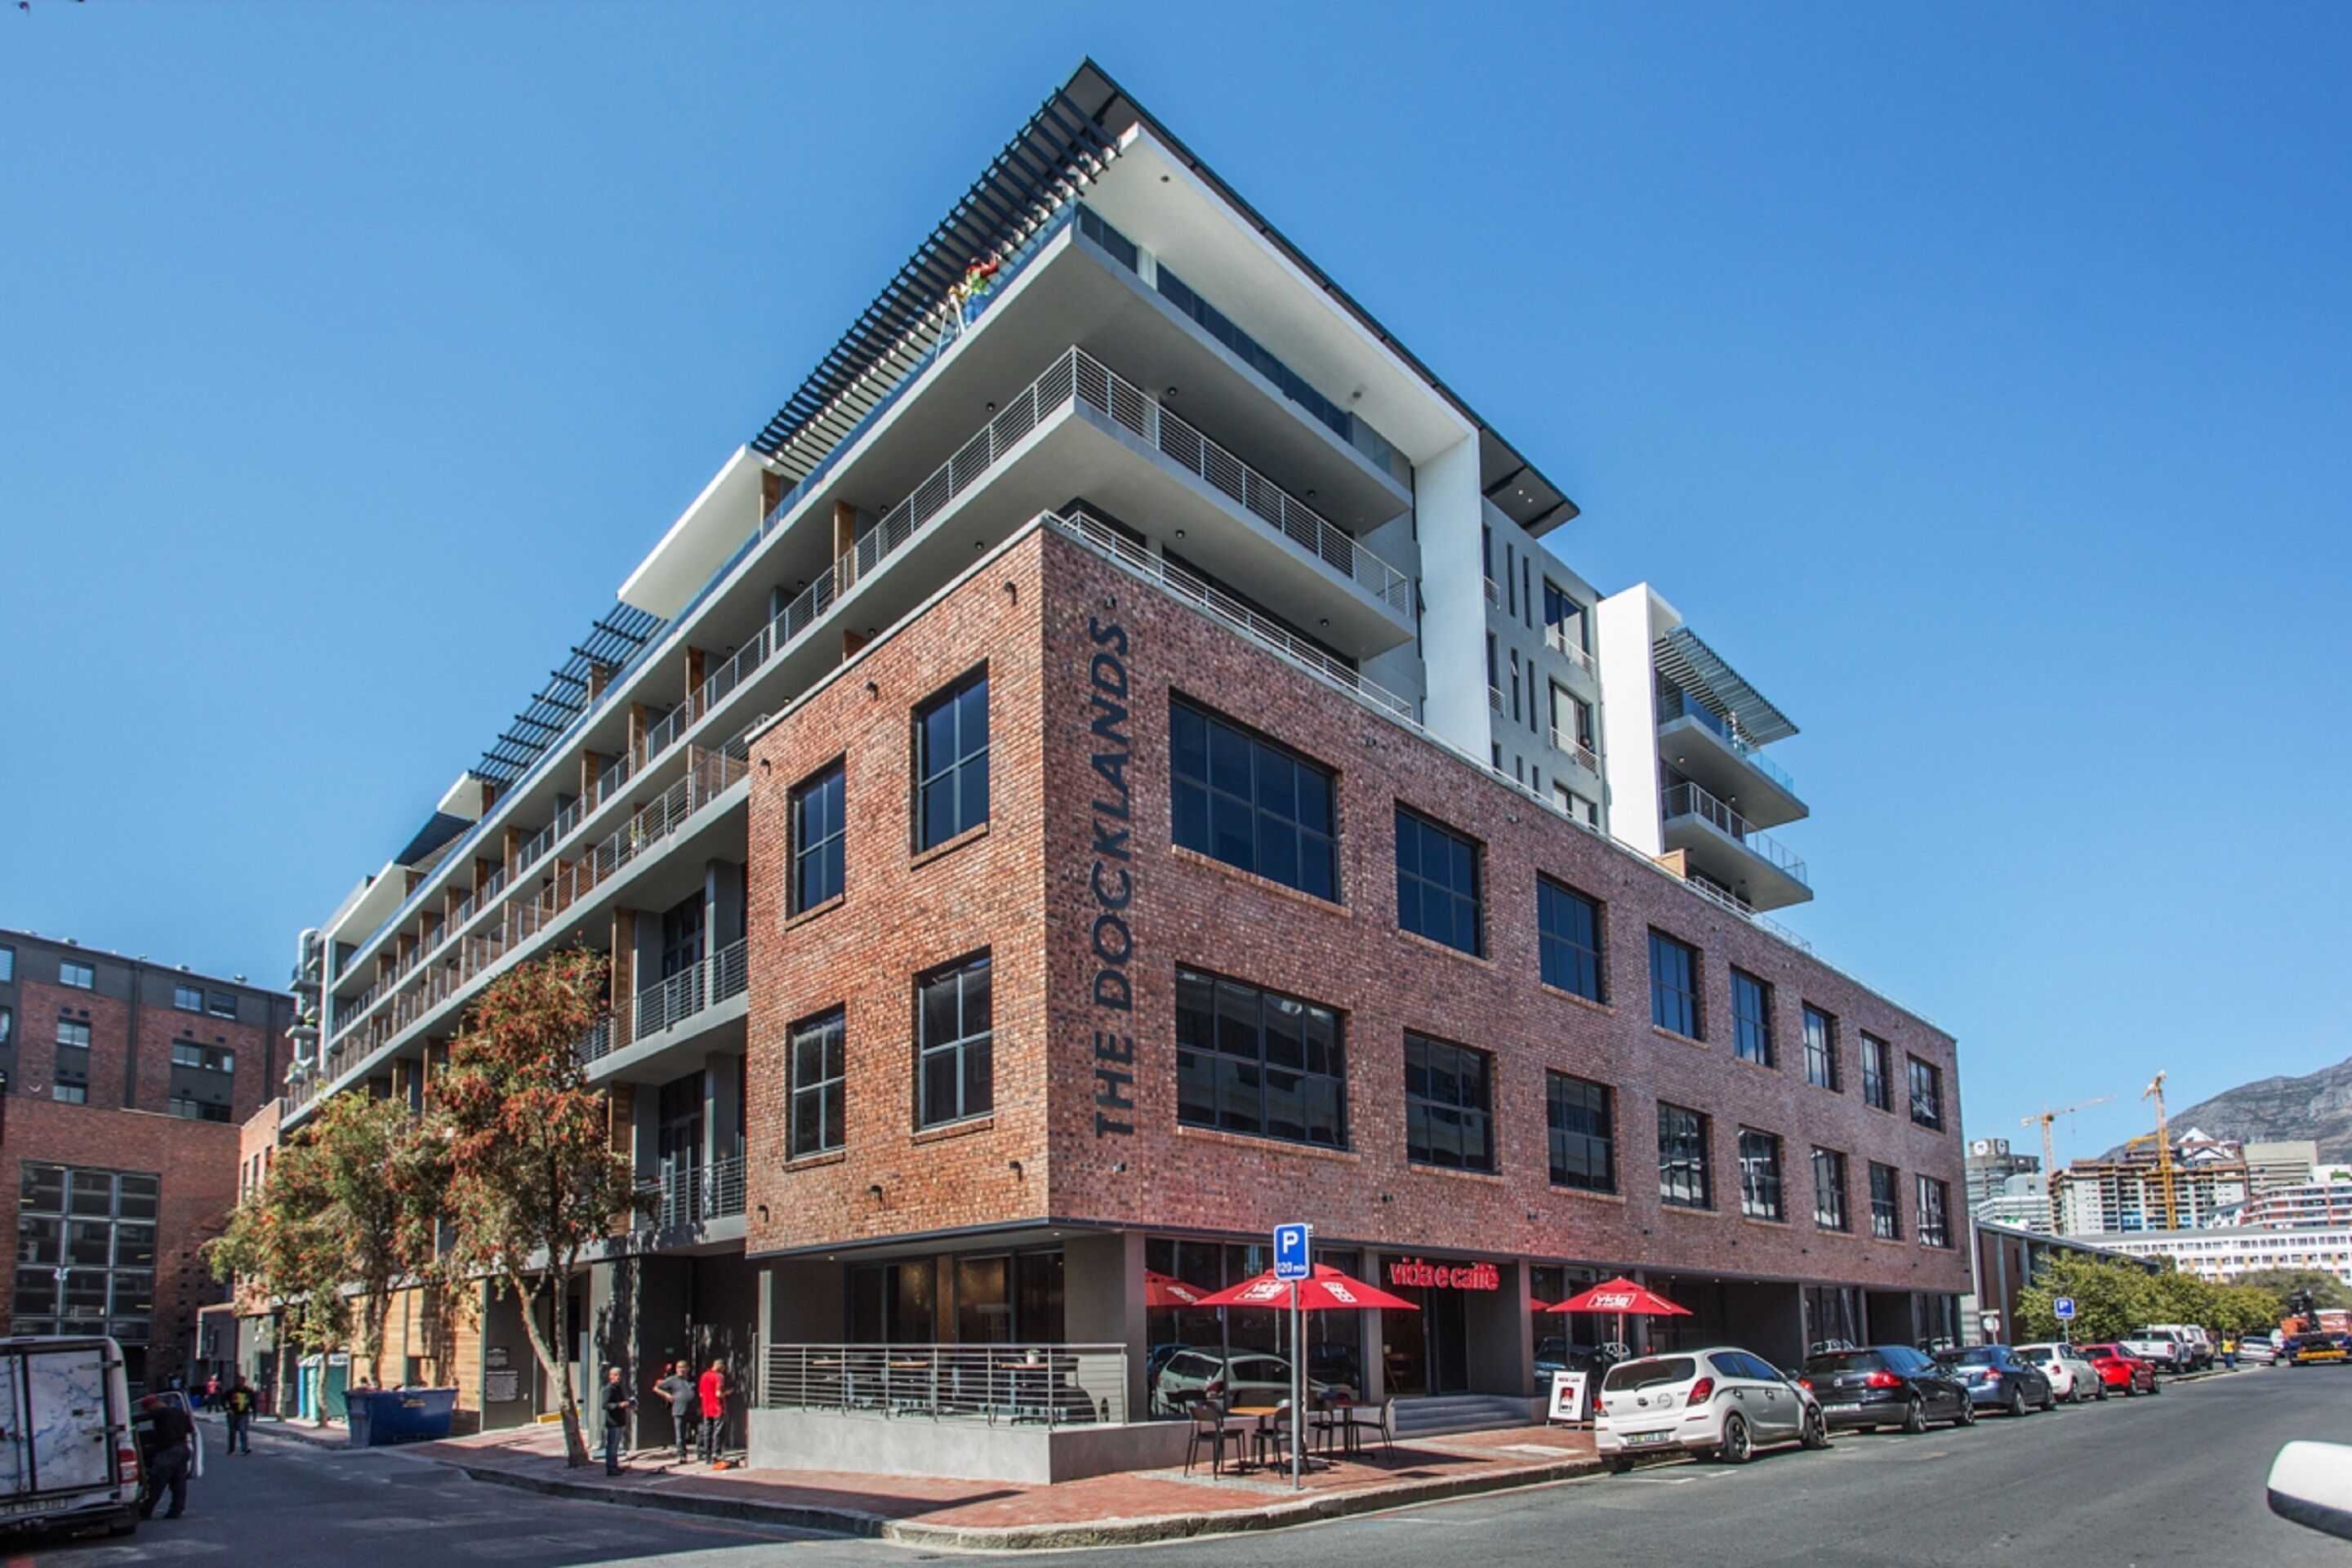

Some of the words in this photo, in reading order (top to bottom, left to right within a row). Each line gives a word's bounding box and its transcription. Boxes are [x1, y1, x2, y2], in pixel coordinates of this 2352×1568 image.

[1089, 617, 1133, 1011] DOCKLANDS
[1094, 1030, 1134, 1138] THE
[1283, 1231, 1298, 1254] P
[1390, 1257, 1435, 1287] vida
[1435, 1265, 1450, 1289] e
[2059, 1301, 2069, 1310] P
